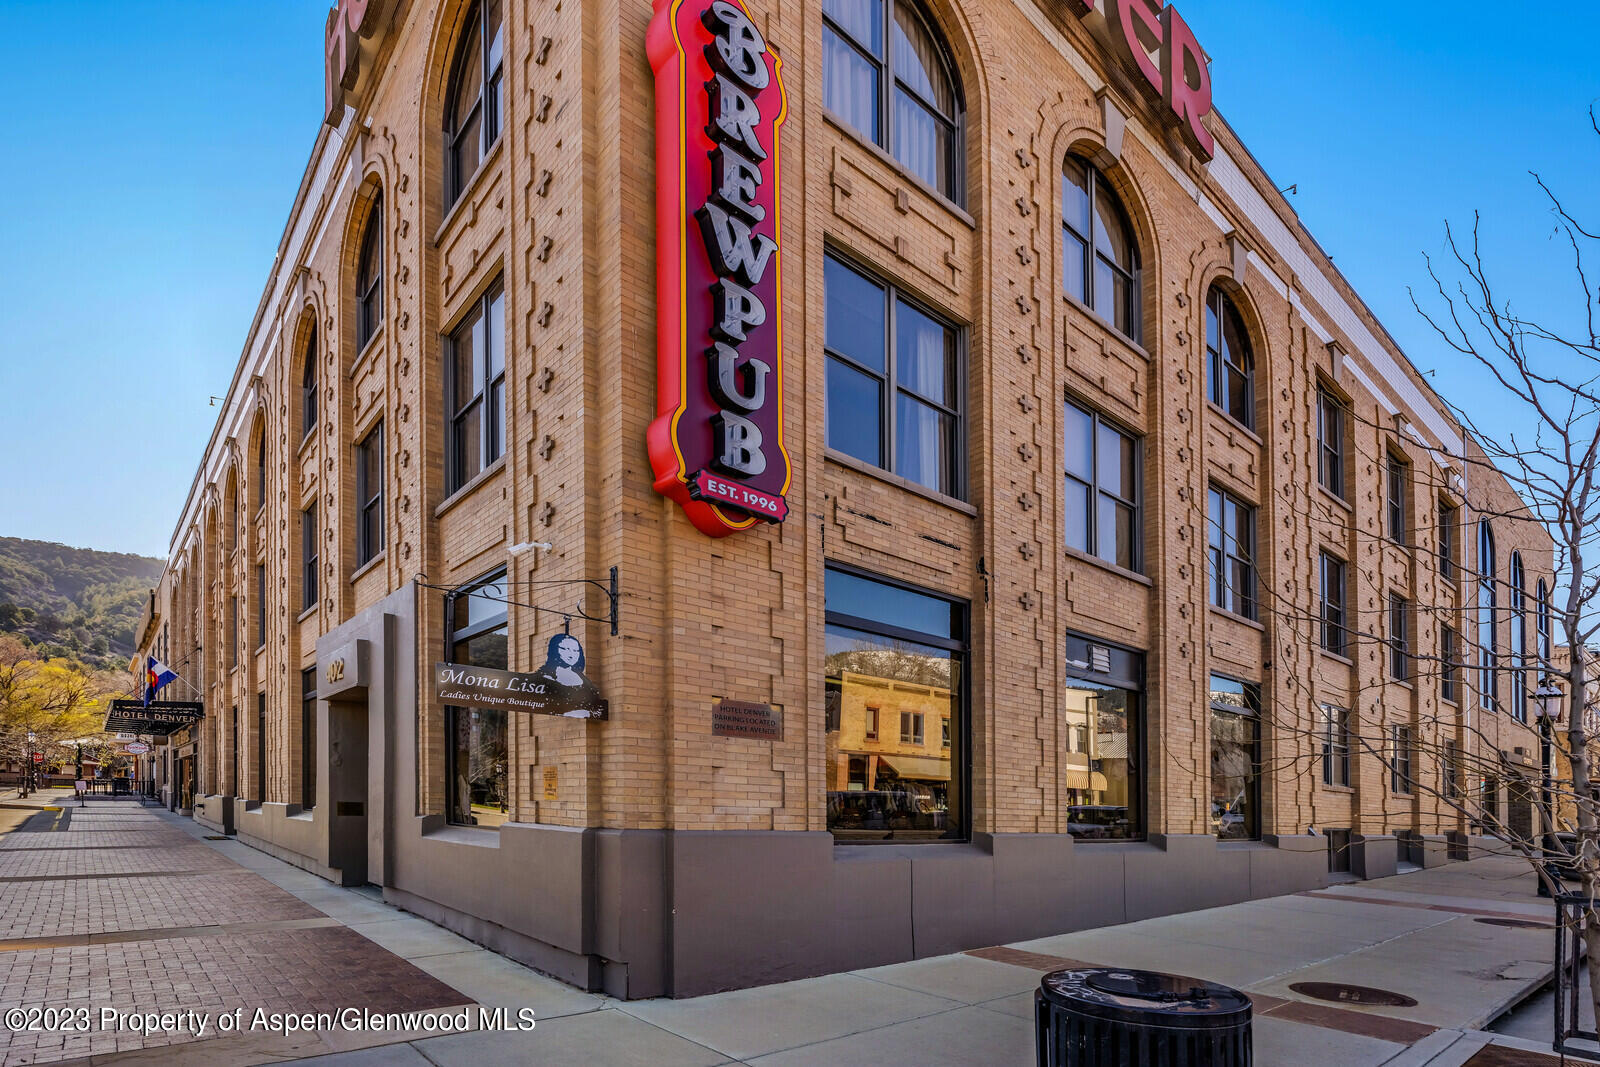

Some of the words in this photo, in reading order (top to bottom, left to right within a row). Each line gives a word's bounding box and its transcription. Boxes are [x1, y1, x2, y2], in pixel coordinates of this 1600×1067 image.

[703, 0, 779, 476] BREWPUB
[707, 479, 739, 500] EST.
[742, 490, 777, 512] 1996
[440, 669, 500, 689] Mona
[505, 677, 546, 695] Lisa
[439, 690, 470, 700] Ladies
[473, 693, 505, 706] Unique
[507, 697, 545, 709] Boutique
[114, 710, 149, 719] HOTEL
[154, 713, 195, 723] DENVER
[720, 705, 742, 714] HOTEL
[743, 708, 770, 717] DENVER
[714, 713, 745, 723] PARKING
[745, 718, 776, 727] LOCATED
[726, 724, 747, 732] BLAKE
[750, 727, 776, 735] AVENUE
